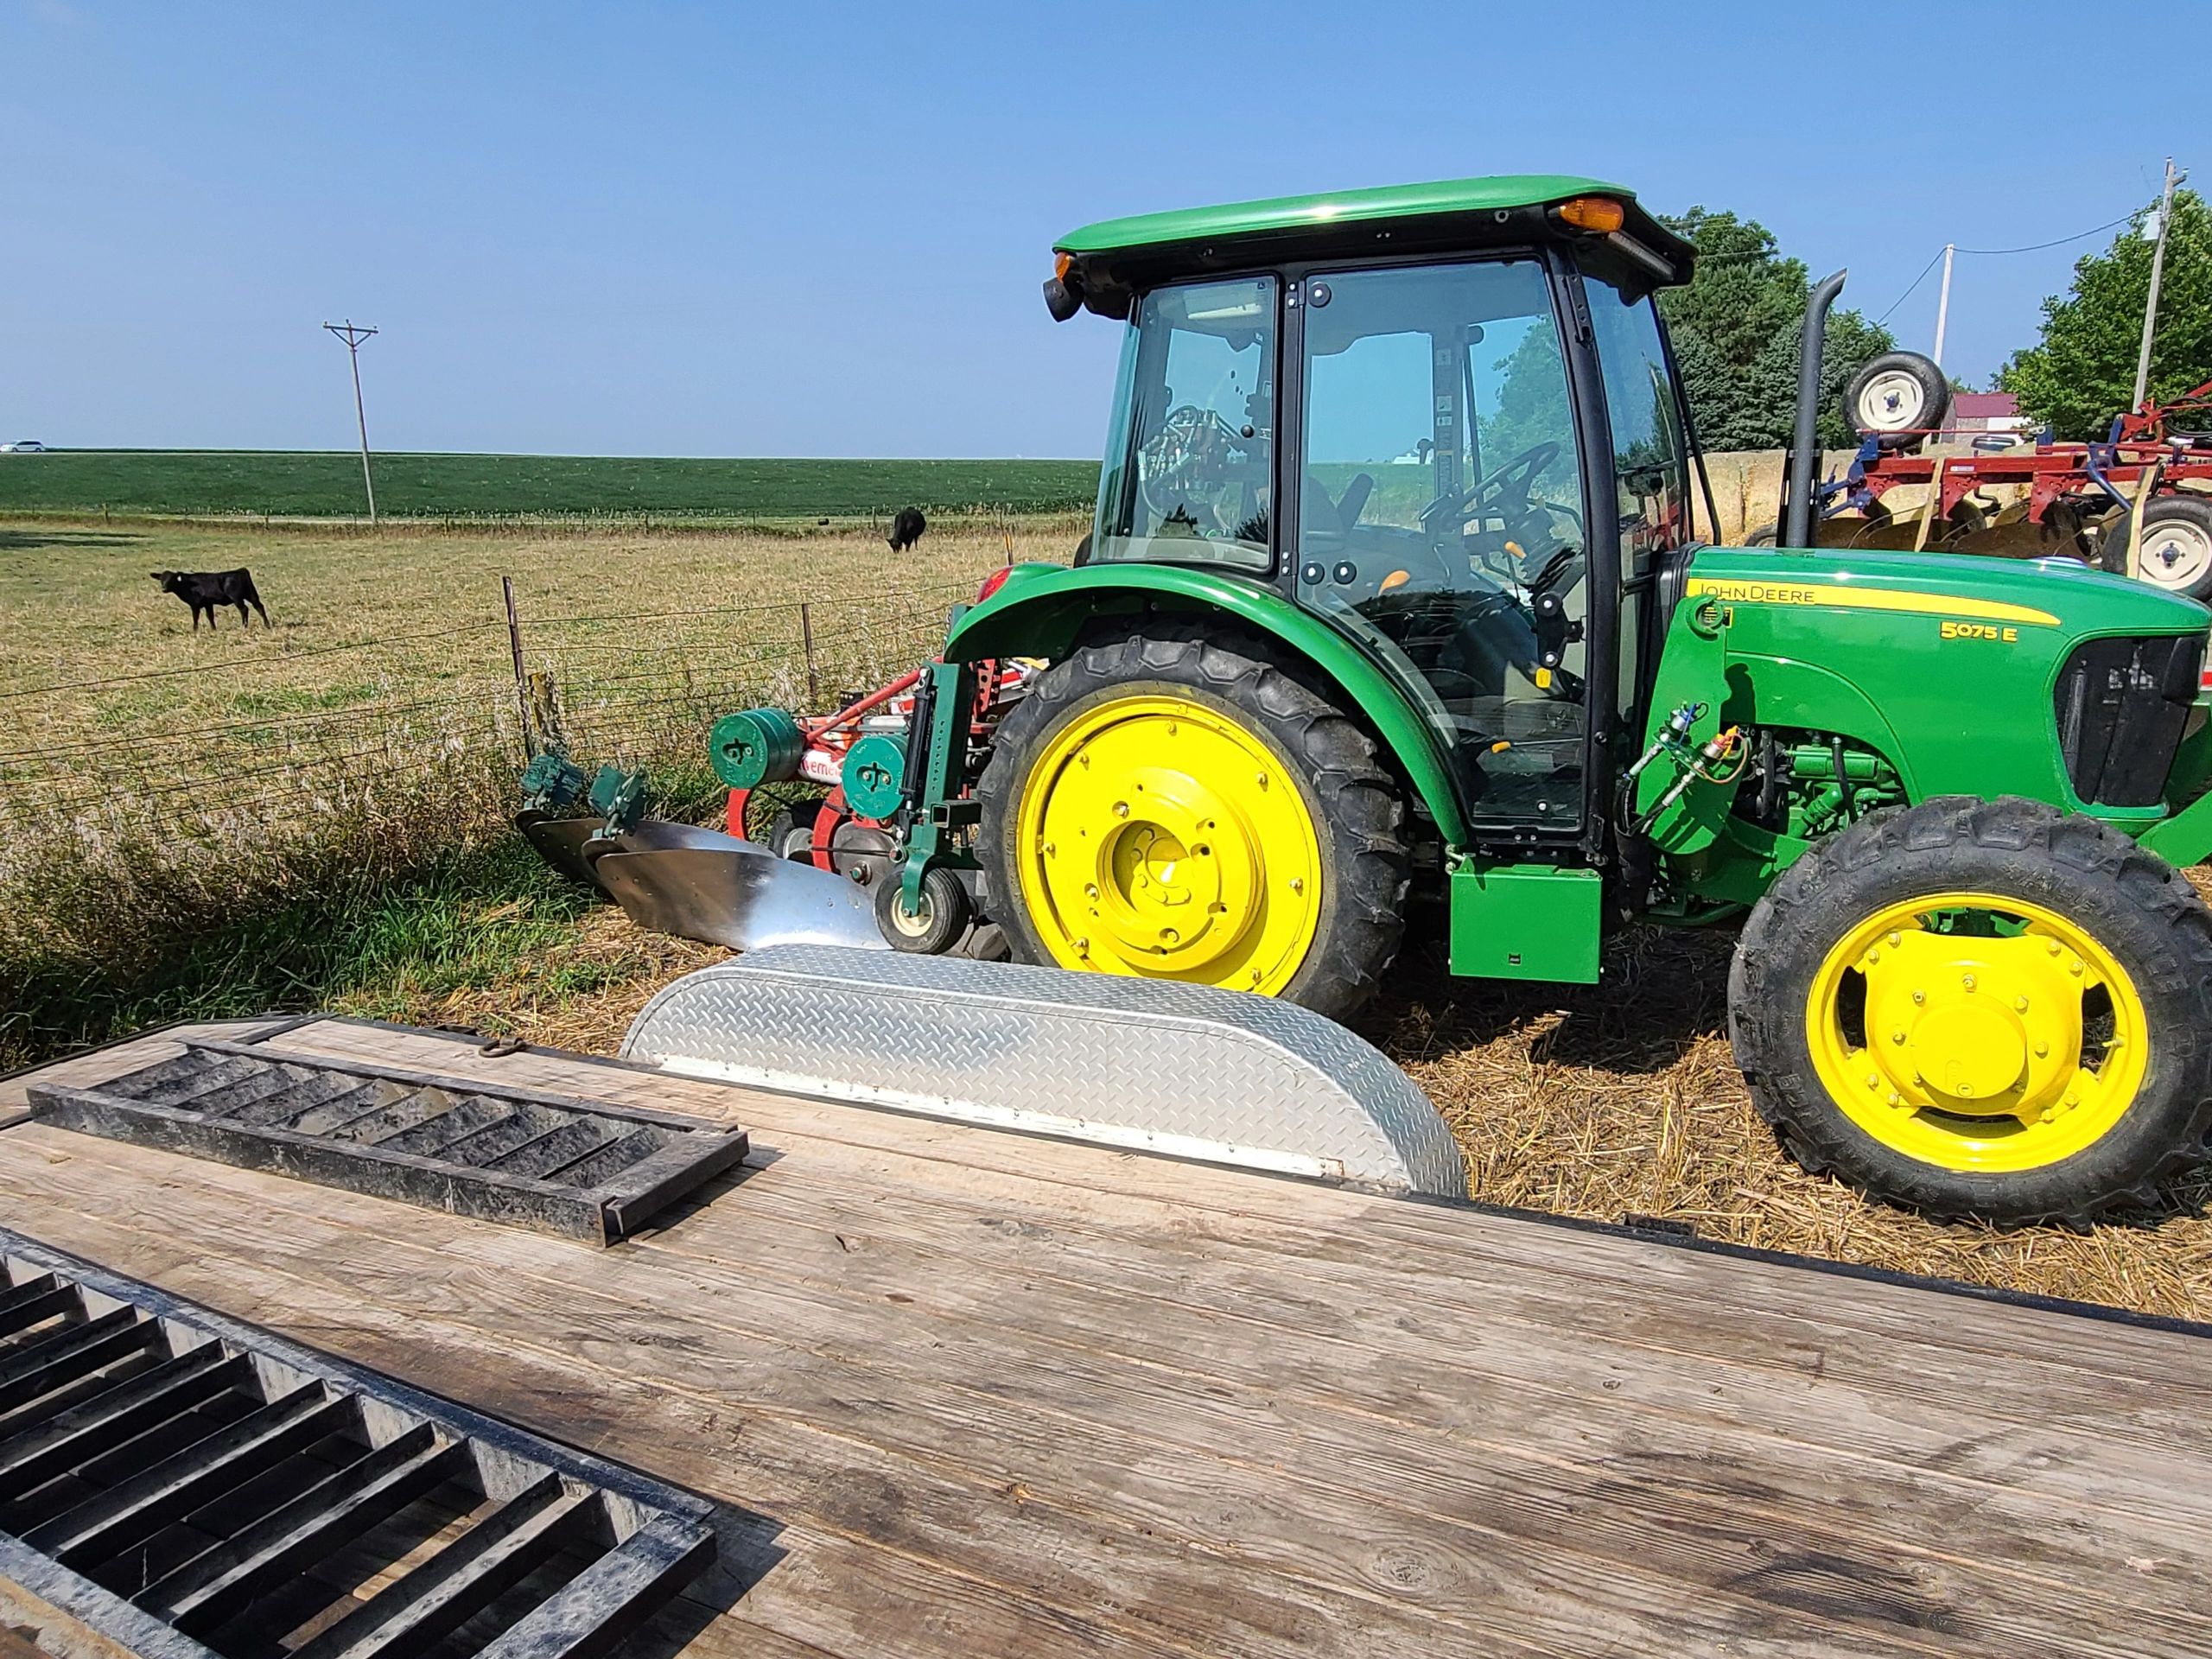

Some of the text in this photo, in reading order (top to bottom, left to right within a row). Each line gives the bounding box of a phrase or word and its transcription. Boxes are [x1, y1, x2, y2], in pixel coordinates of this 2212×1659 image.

[1700, 583, 1815, 602] JOHN DEERE
[1940, 621, 2018, 642] 5075 E
